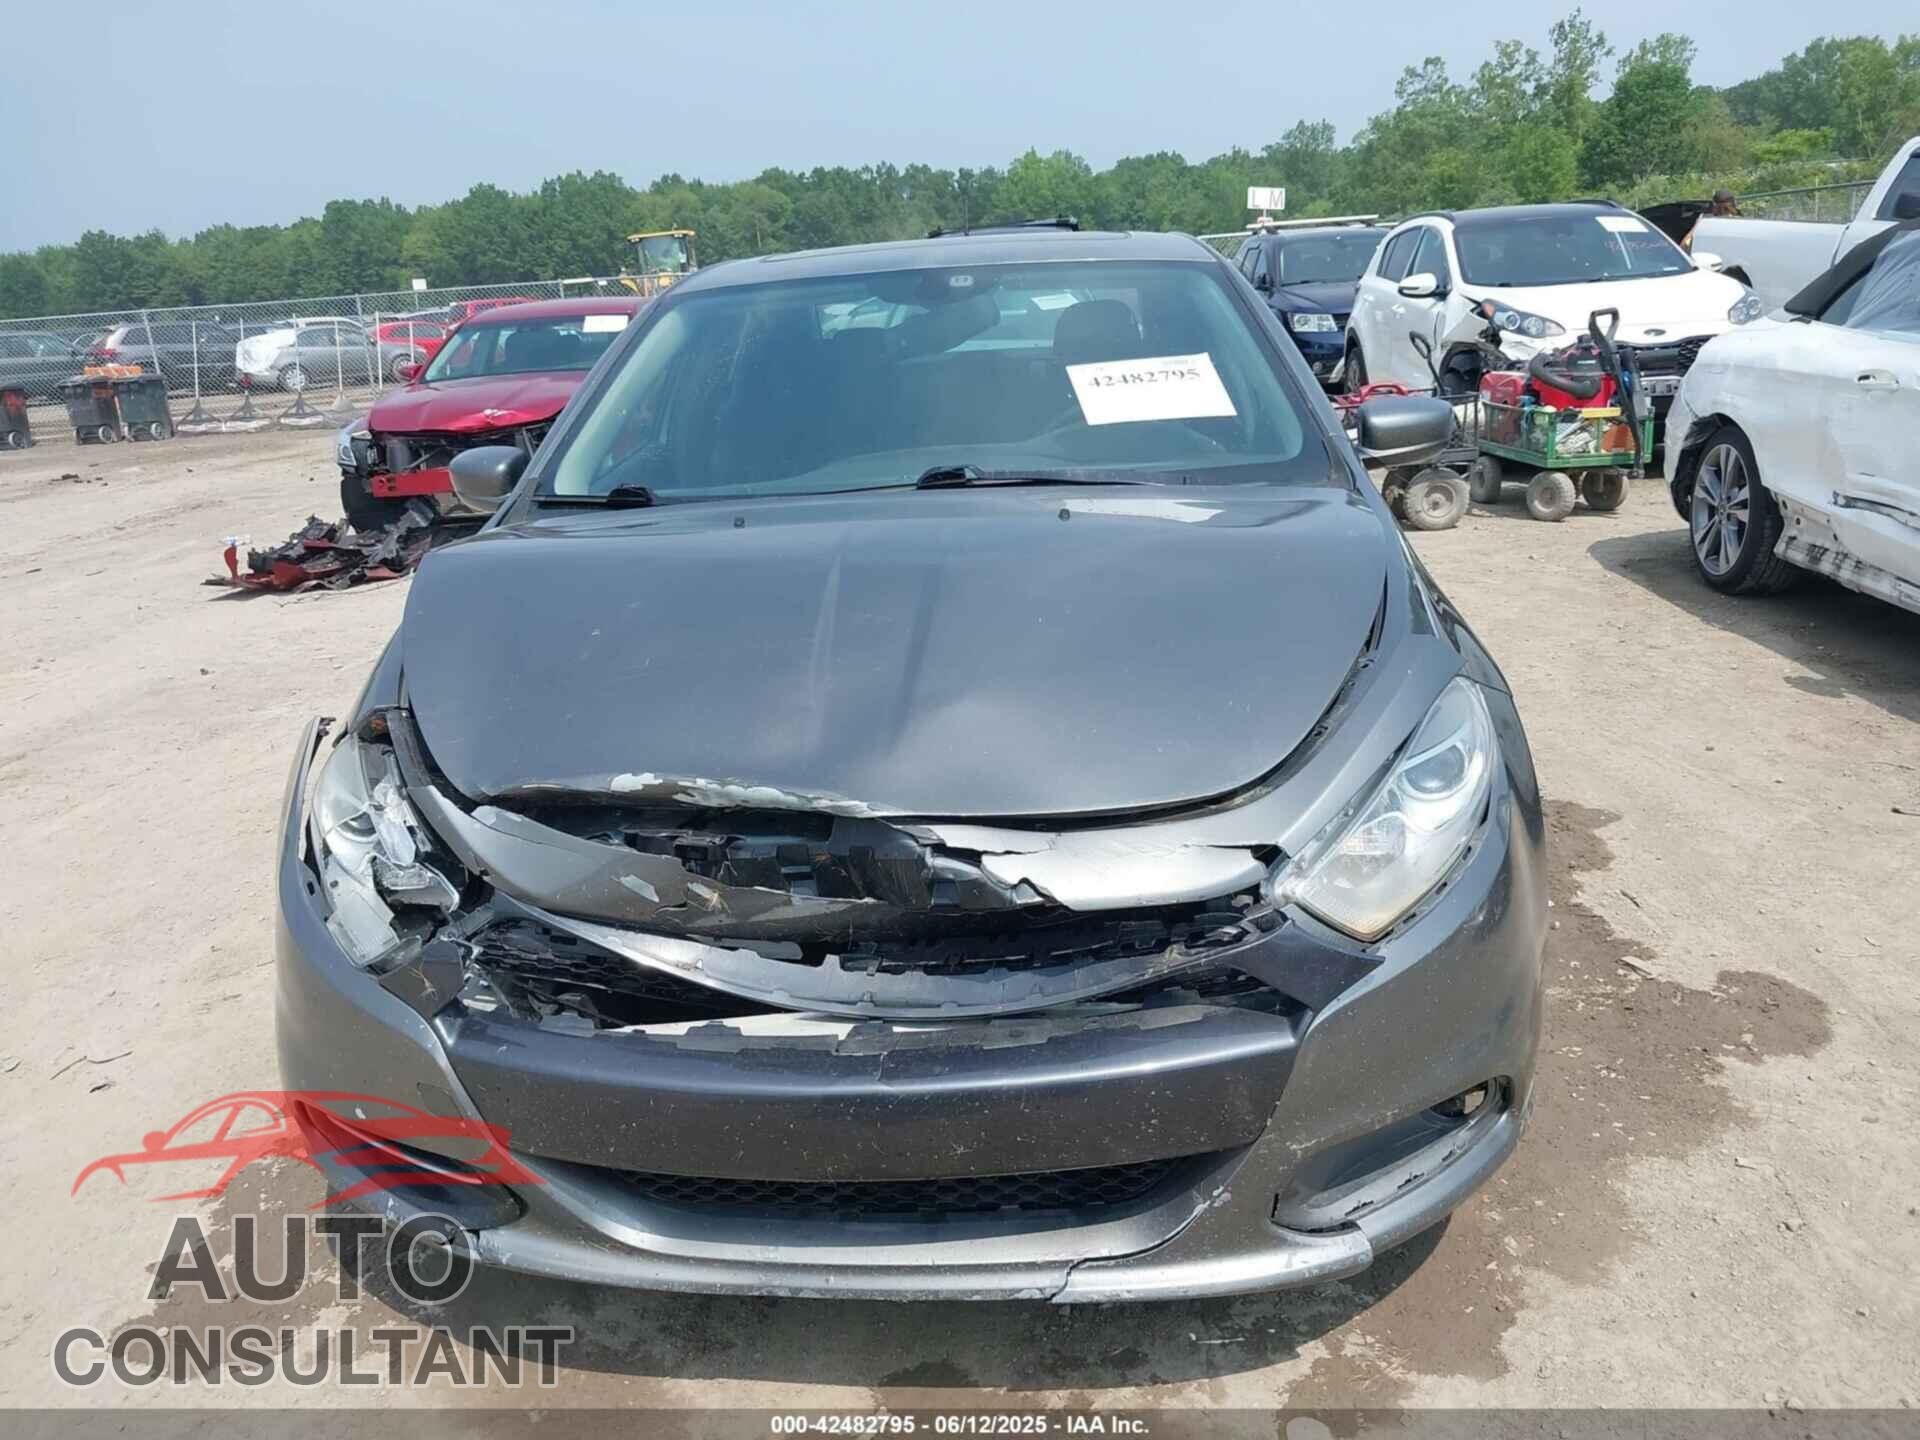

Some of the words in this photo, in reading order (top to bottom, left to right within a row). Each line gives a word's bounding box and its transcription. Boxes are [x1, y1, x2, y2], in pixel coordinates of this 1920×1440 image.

[1252, 190, 1261, 208] L
[1270, 190, 1283, 208] M
[1089, 368, 1200, 388] 42482795
